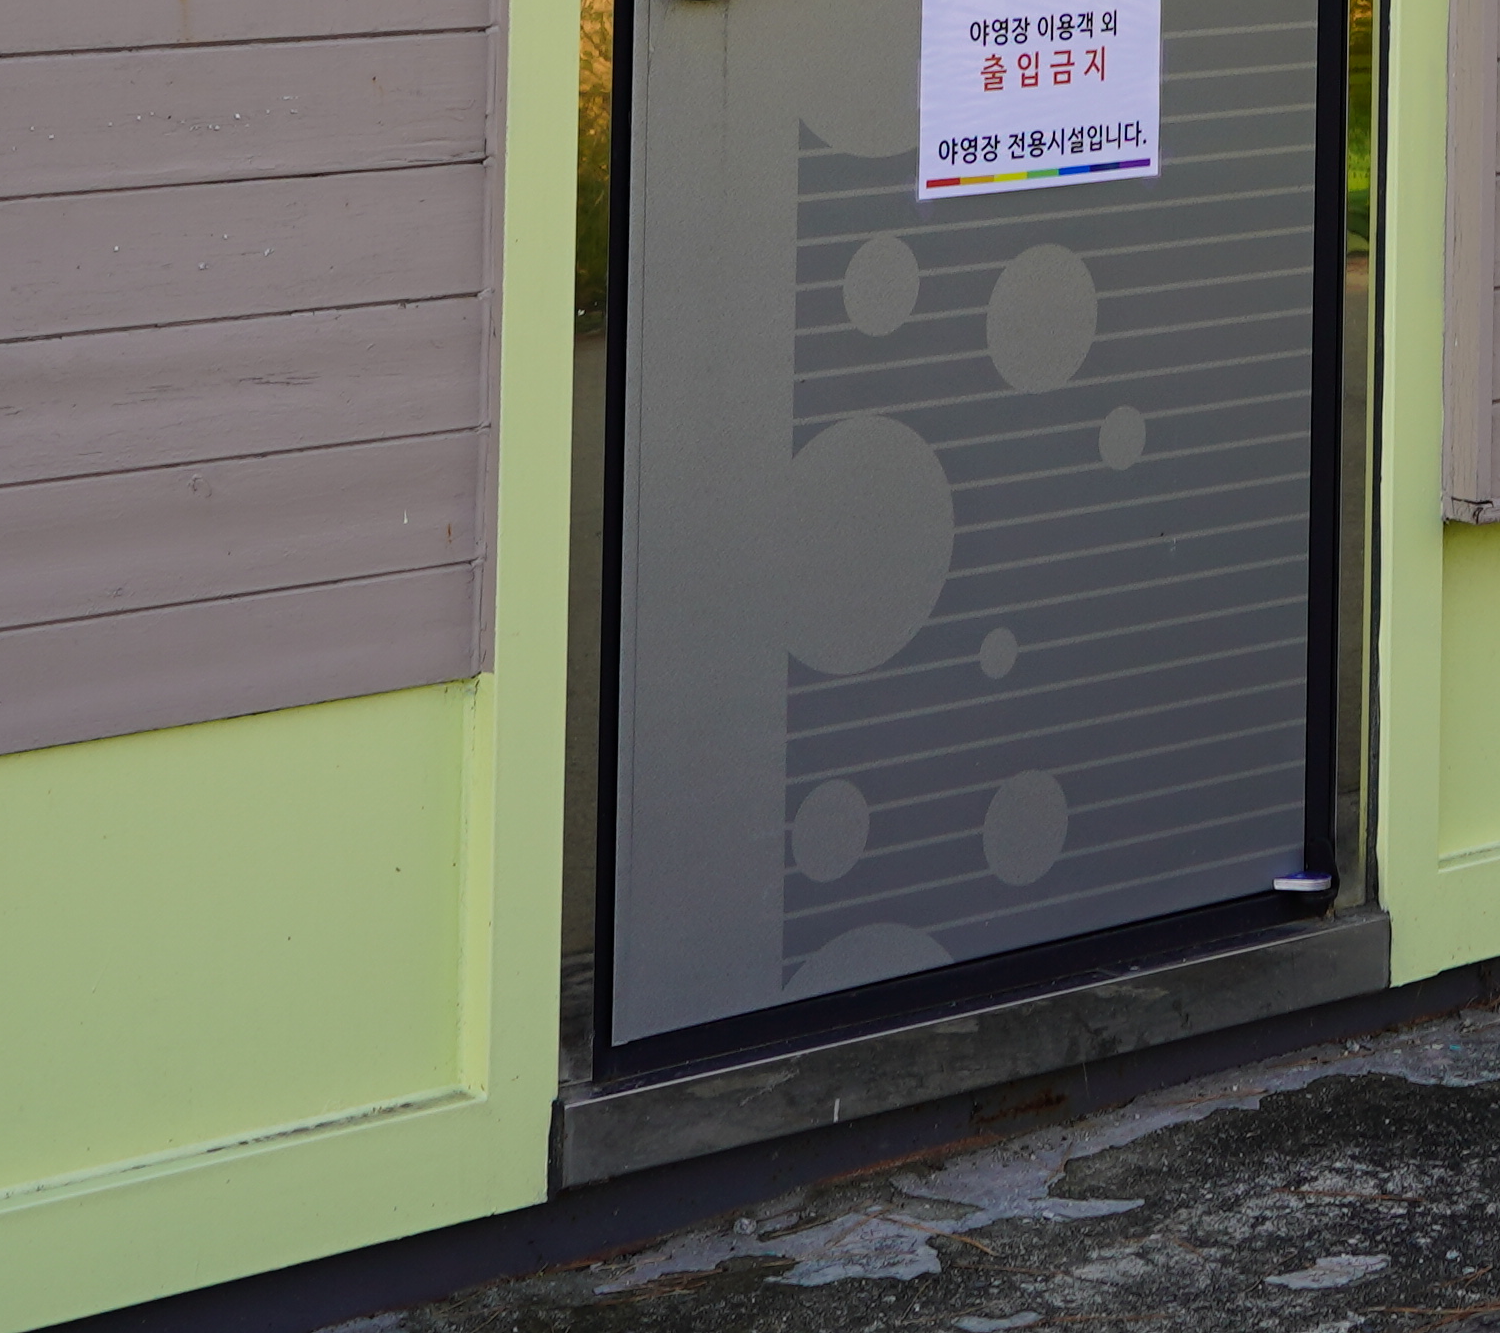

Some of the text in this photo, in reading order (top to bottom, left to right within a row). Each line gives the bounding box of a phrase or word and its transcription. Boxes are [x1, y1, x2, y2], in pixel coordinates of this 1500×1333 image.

[969, 9, 1117, 47] 야영장 이용객 외
[937, 120, 1147, 166] 야영장 전용시설입니다.
